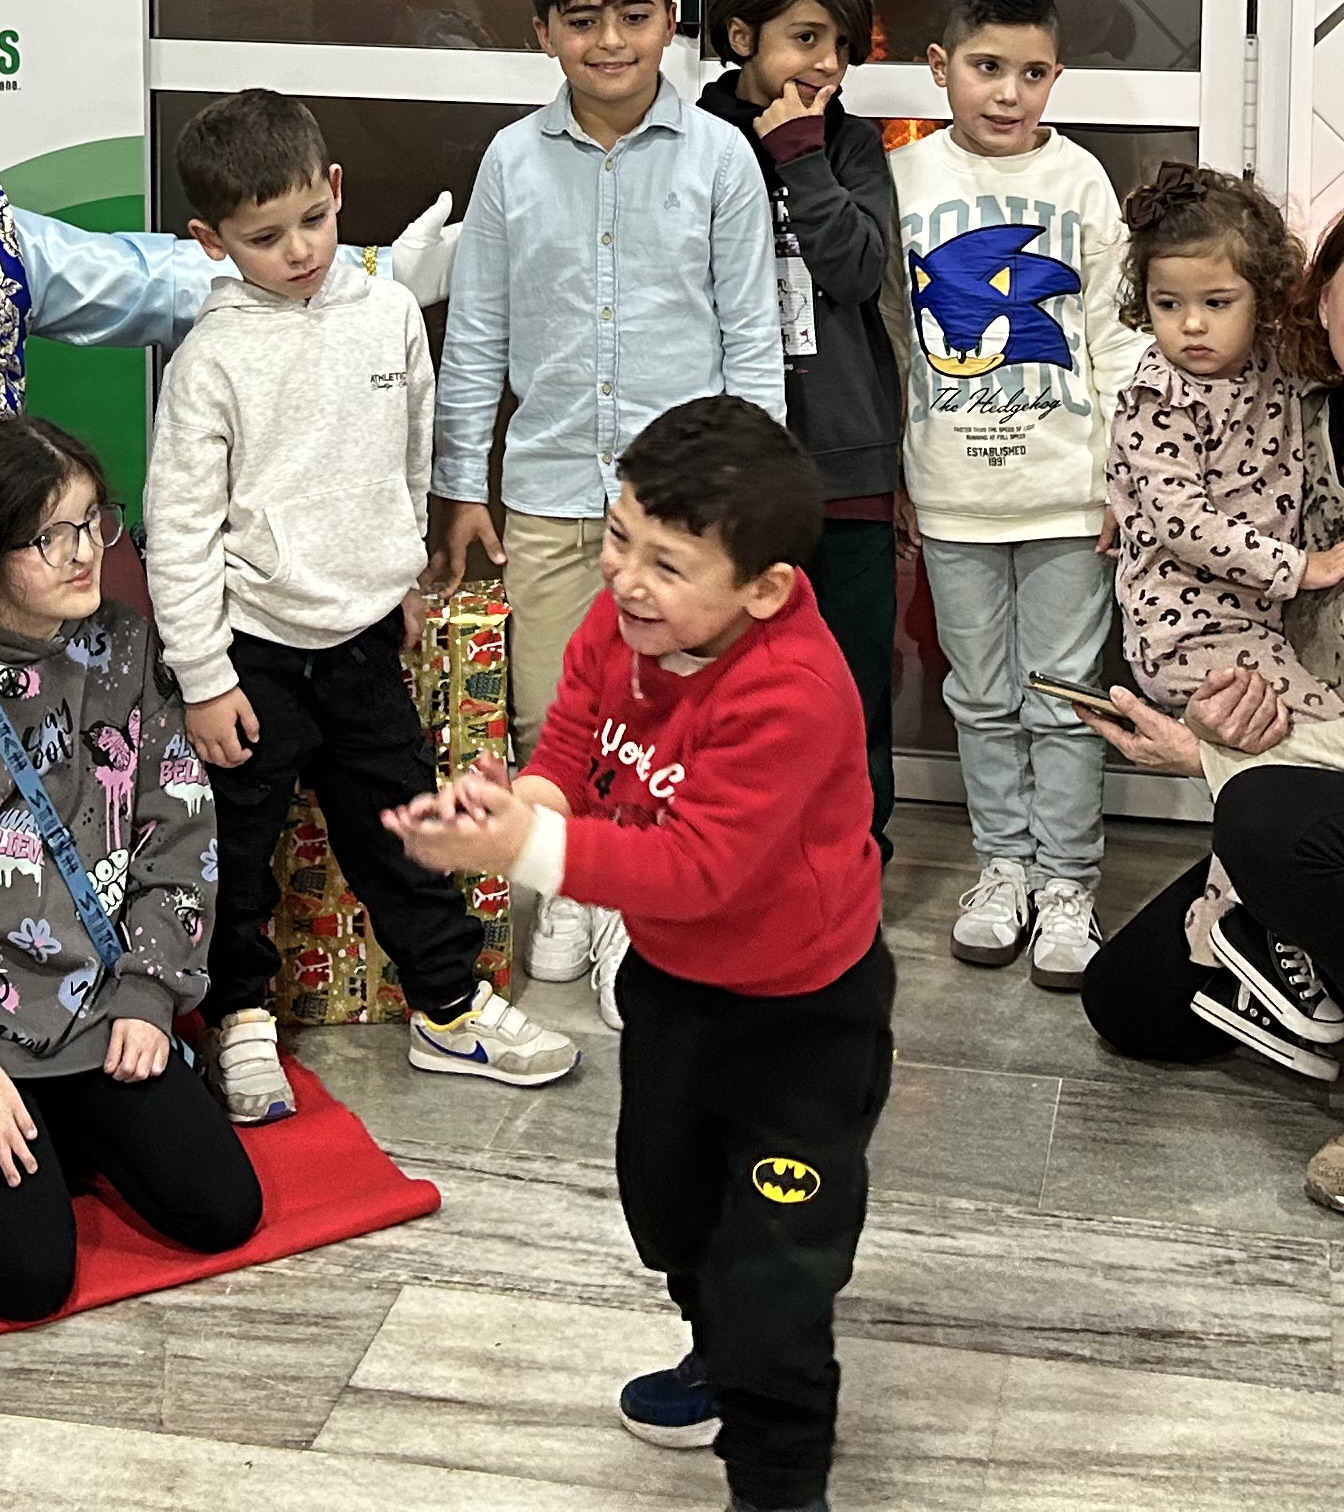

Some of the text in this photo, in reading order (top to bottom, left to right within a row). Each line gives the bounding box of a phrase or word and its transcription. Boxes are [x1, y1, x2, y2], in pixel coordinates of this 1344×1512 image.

[930, 386, 1062, 425] The Hedgehog
[966, 445, 1027, 457] ESTABLISHED
[988, 456, 1007, 467] 1991
